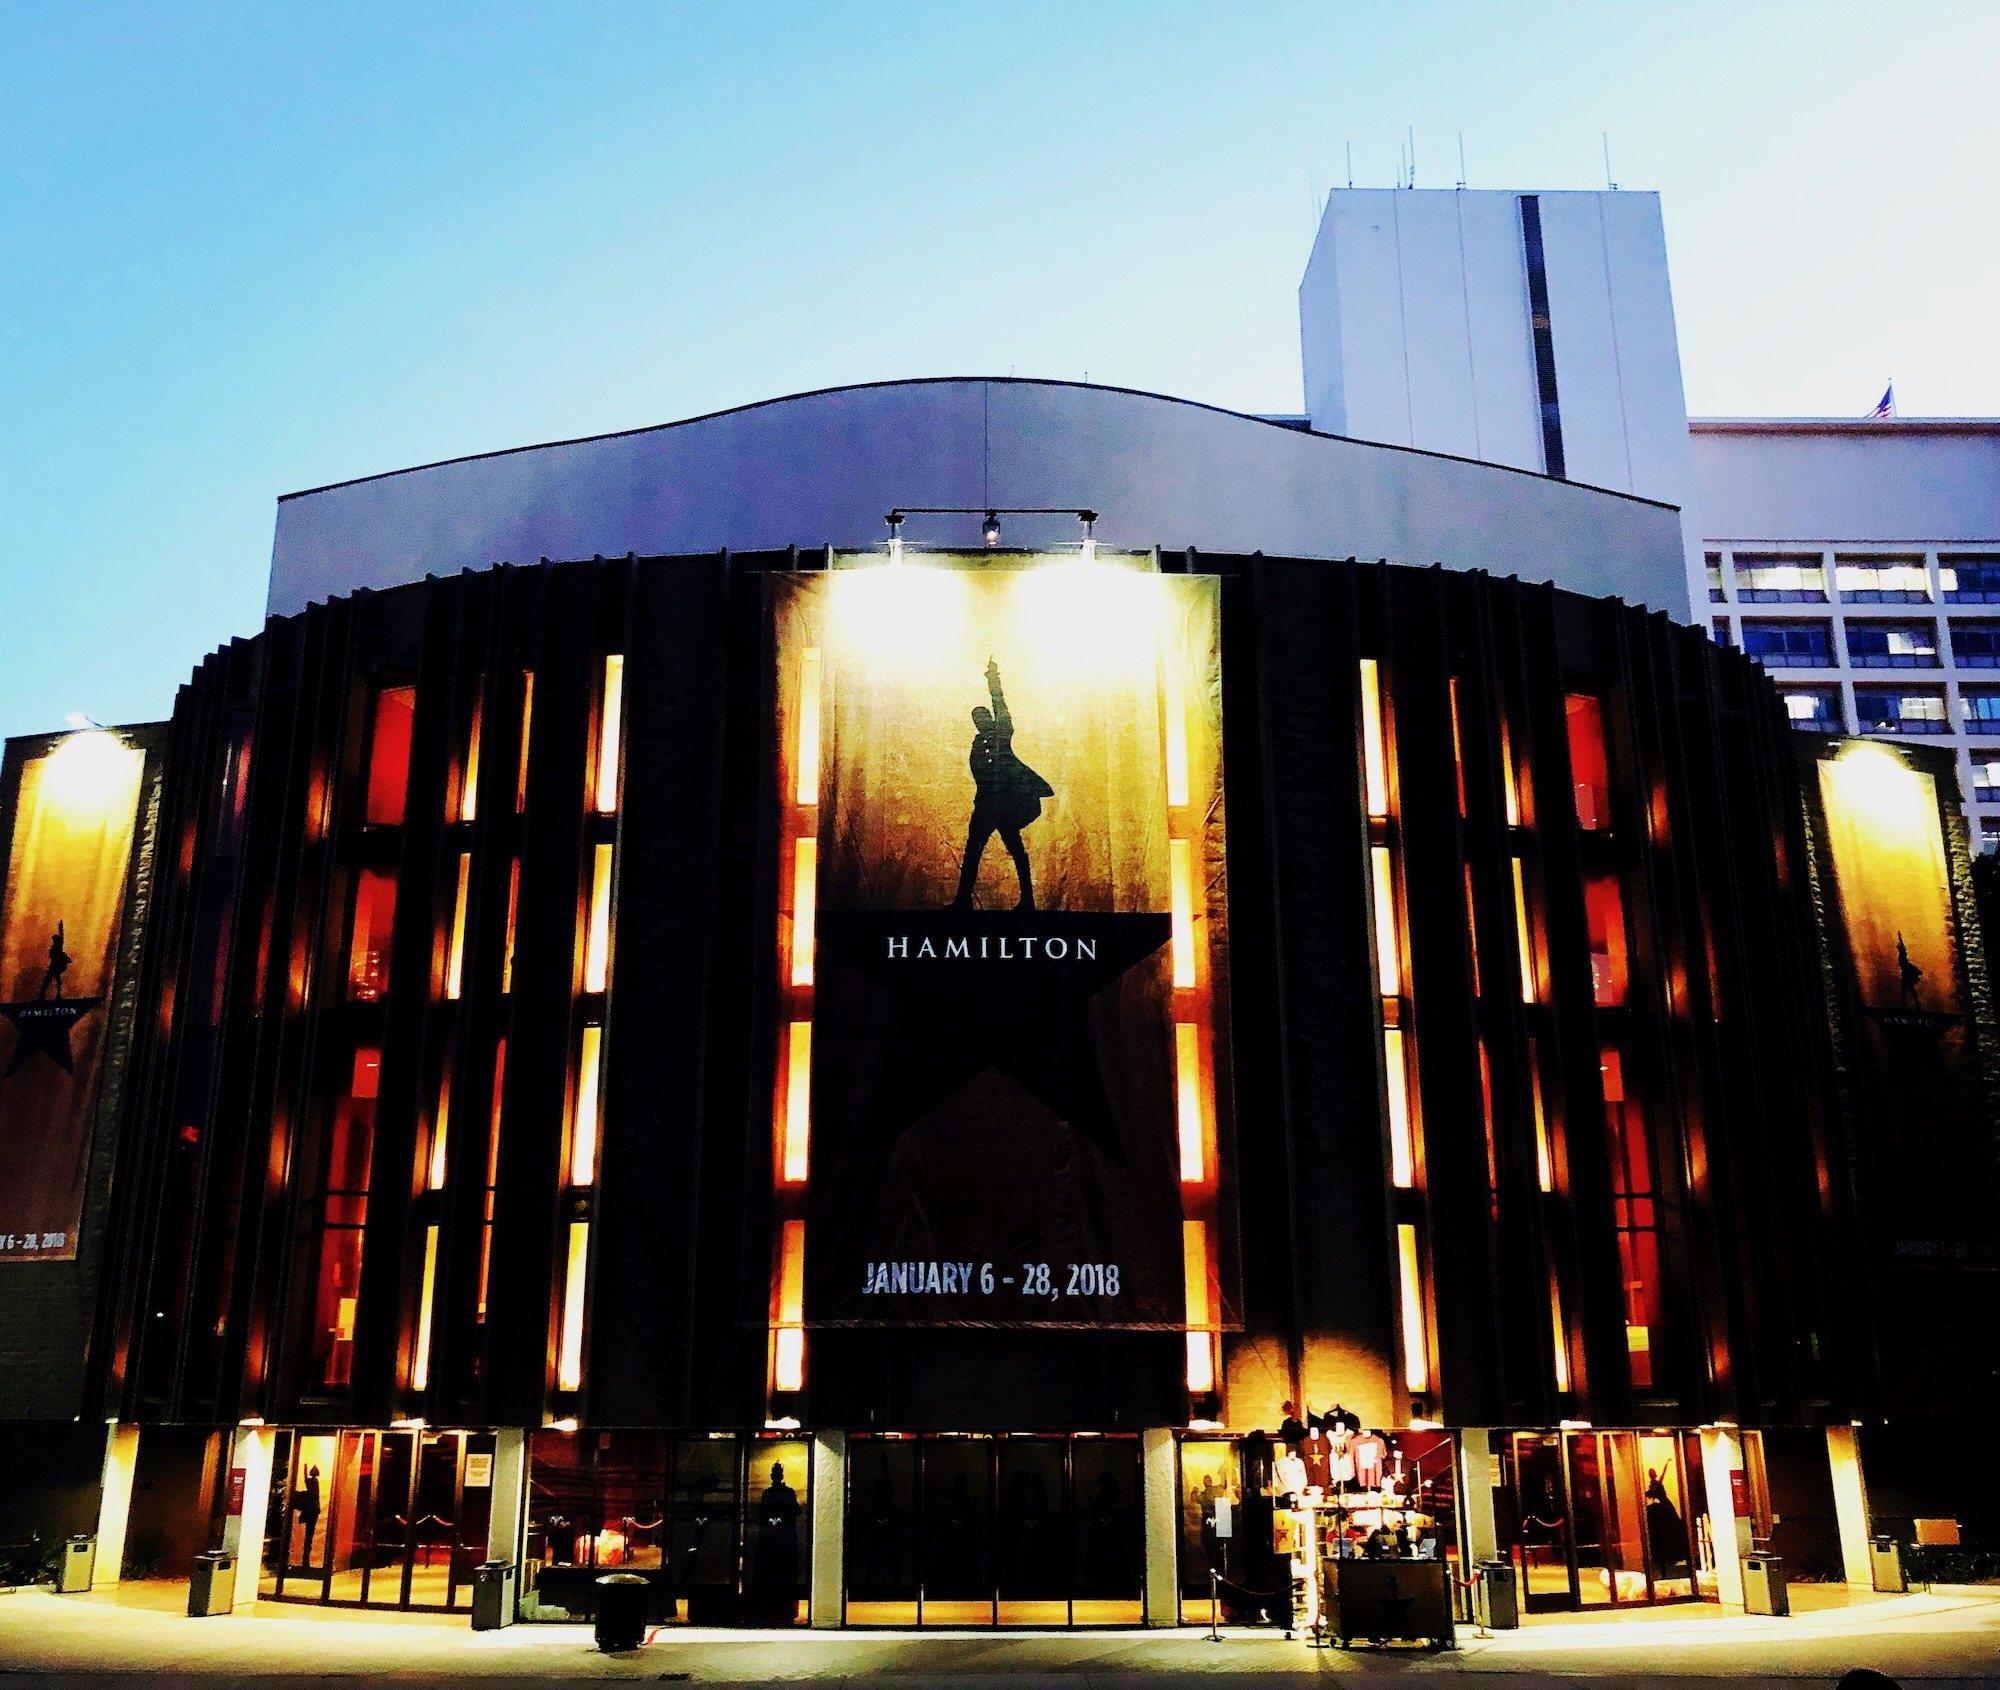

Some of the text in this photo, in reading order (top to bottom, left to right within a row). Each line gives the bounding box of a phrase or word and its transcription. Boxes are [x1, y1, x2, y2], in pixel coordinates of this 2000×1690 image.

[887, 937, 1097, 960] HAMILTON
[7, 1234, 15, 1250] 6
[862, 1262, 973, 1295] JANUARY
[980, 1263, 995, 1295] 6
[1022, 1263, 1059, 1301] 28,
[1066, 1263, 1120, 1296] 2018
